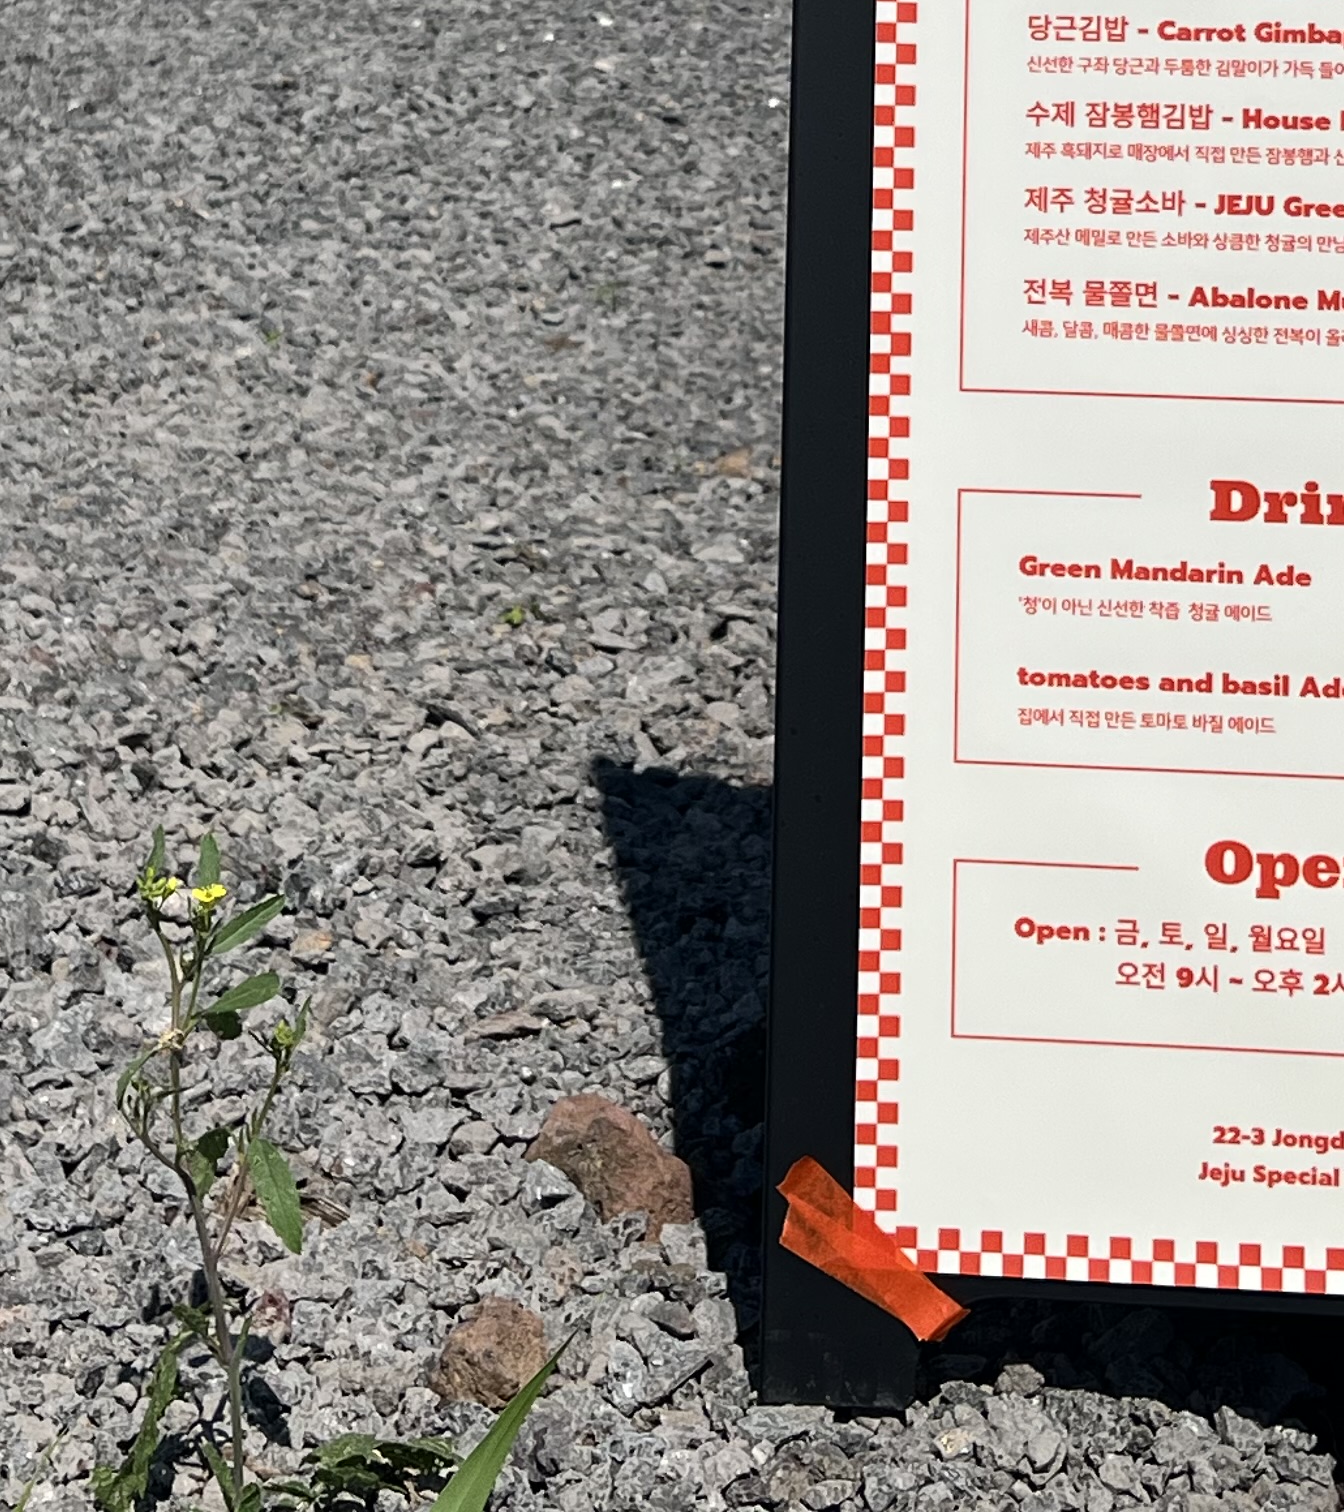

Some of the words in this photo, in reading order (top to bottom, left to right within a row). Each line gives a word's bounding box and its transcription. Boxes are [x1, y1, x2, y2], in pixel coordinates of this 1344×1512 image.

[1028, 14, 1129, 42] 당근김밥
[1157, 20, 1246, 42] Carrot
[1027, 56, 1073, 73] 신선한
[1079, 56, 1109, 74] 구좌
[1113, 57, 1160, 75] 당근과
[1164, 59, 1211, 76] 두툼한
[1216, 60, 1279, 77] 김말이가
[1284, 60, 1315, 79] 가득
[1026, 101, 1075, 128] 수제
[1085, 101, 1214, 130] 잠봉햄김밥
[1242, 108, 1331, 131] House
[1025, 142, 1057, 159] 제주
[1061, 142, 1123, 160] 흑돼지로
[1128, 143, 1189, 162] 매장에서
[1196, 146, 1225, 163] 직접
[1230, 147, 1262, 164] 만든
[1266, 148, 1330, 166] 잠봉햄과
[1024, 186, 1075, 213] 제주
[1084, 187, 1186, 216] 청귤소바
[1214, 194, 1275, 216] JEJU
[1024, 228, 1070, 245] 제주산
[1075, 229, 1122, 247] 메밀로
[1126, 231, 1157, 248] 만든
[1161, 232, 1209, 249] 소바와
[1213, 233, 1261, 251] 상큼한
[1265, 234, 1312, 252] 청귤의
[1024, 278, 1073, 306] 전복
[1083, 280, 1157, 308] 물쫄면
[1188, 286, 1308, 310] Abalone
[1022, 319, 1058, 338] 새콤,
[1063, 321, 1098, 339] 달콤,
[1103, 321, 1150, 340] 매콤한
[1222, 326, 1268, 344] 싱싱한
[1274, 328, 1320, 345] 전복이
[1019, 555, 1101, 579] Green
[1111, 558, 1244, 584] Mandarin
[1253, 564, 1312, 587] Ade
[1062, 599, 1092, 616] 아닌
[1097, 600, 1143, 618] 신선한
[1149, 601, 1180, 620] 착즙
[1189, 603, 1220, 622] 청귤
[1224, 605, 1272, 622] 에이드
[1017, 667, 1150, 690] tomatoes
[1158, 672, 1213, 693] and
[1222, 672, 1290, 697] basil
[1018, 708, 1064, 726] 집에서
[1070, 710, 1100, 728] 직접
[1105, 712, 1136, 729] 만든
[1140, 712, 1188, 730] 토마토
[1192, 714, 1223, 734] 바질
[1228, 717, 1275, 734] 에이드
[1014, 917, 1090, 945] Open
[1115, 919, 1149, 948] 금,
[1159, 922, 1193, 951] 토,
[1204, 923, 1238, 953] 일,
[1248, 925, 1325, 955] 월요일
[1115, 962, 1165, 990] 오전
[1176, 965, 1218, 993] 9시
[1252, 968, 1304, 997] 오후
[1213, 1126, 1265, 1146] 22-3
[1198, 1162, 1245, 1187] Jeju
[1253, 1165, 1340, 1188] Special
